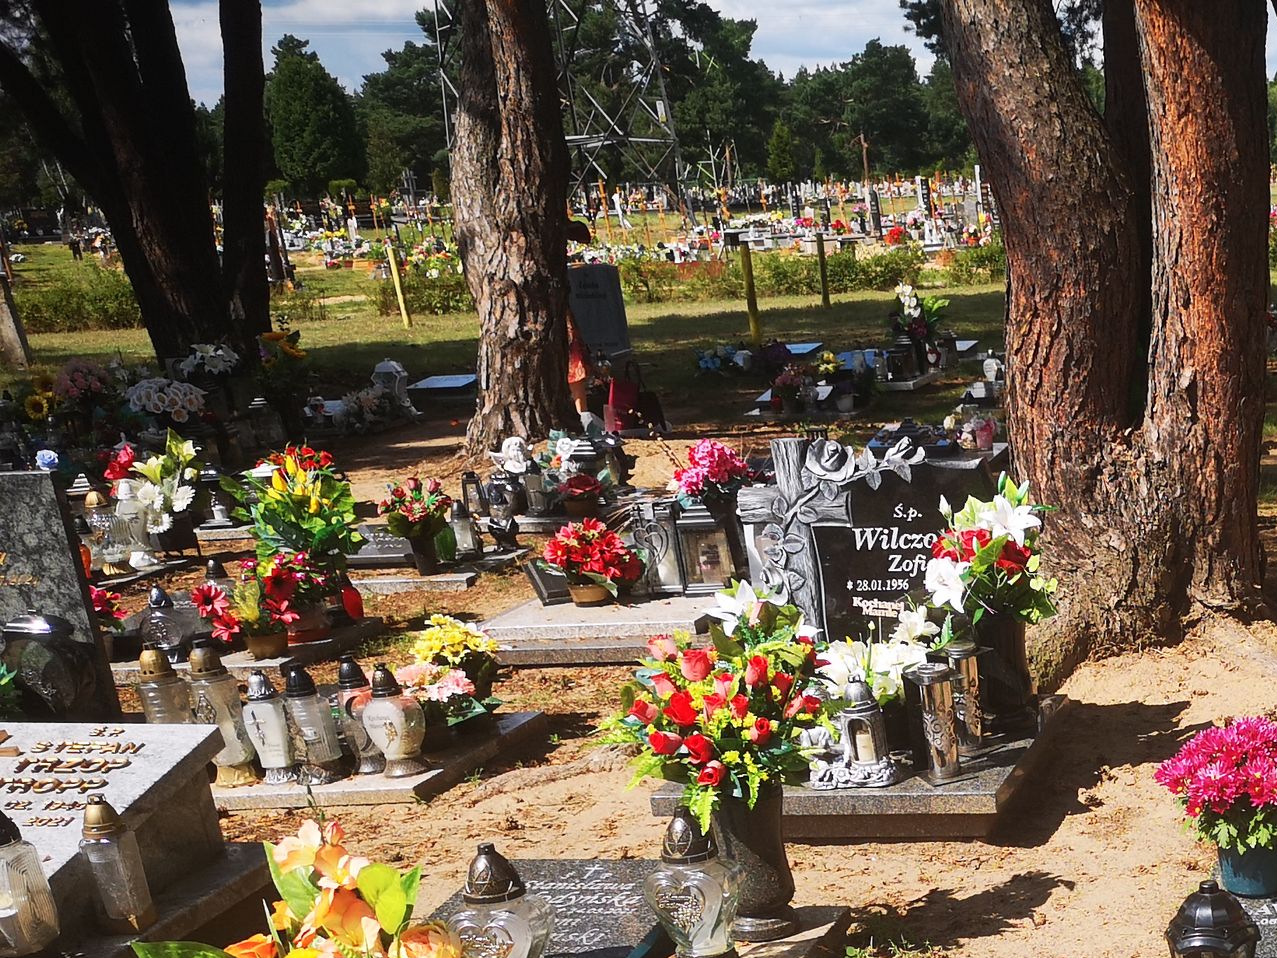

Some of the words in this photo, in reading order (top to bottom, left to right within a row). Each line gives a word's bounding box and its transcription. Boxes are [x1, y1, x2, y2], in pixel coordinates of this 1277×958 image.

[893, 502, 923, 522] Ś.p.
[852, 527, 939, 551] Wilczo
[887, 554, 929, 577] Zofi
[856, 579, 910, 591] 28.01.1956
[31, 740, 146, 754] STEFAN
